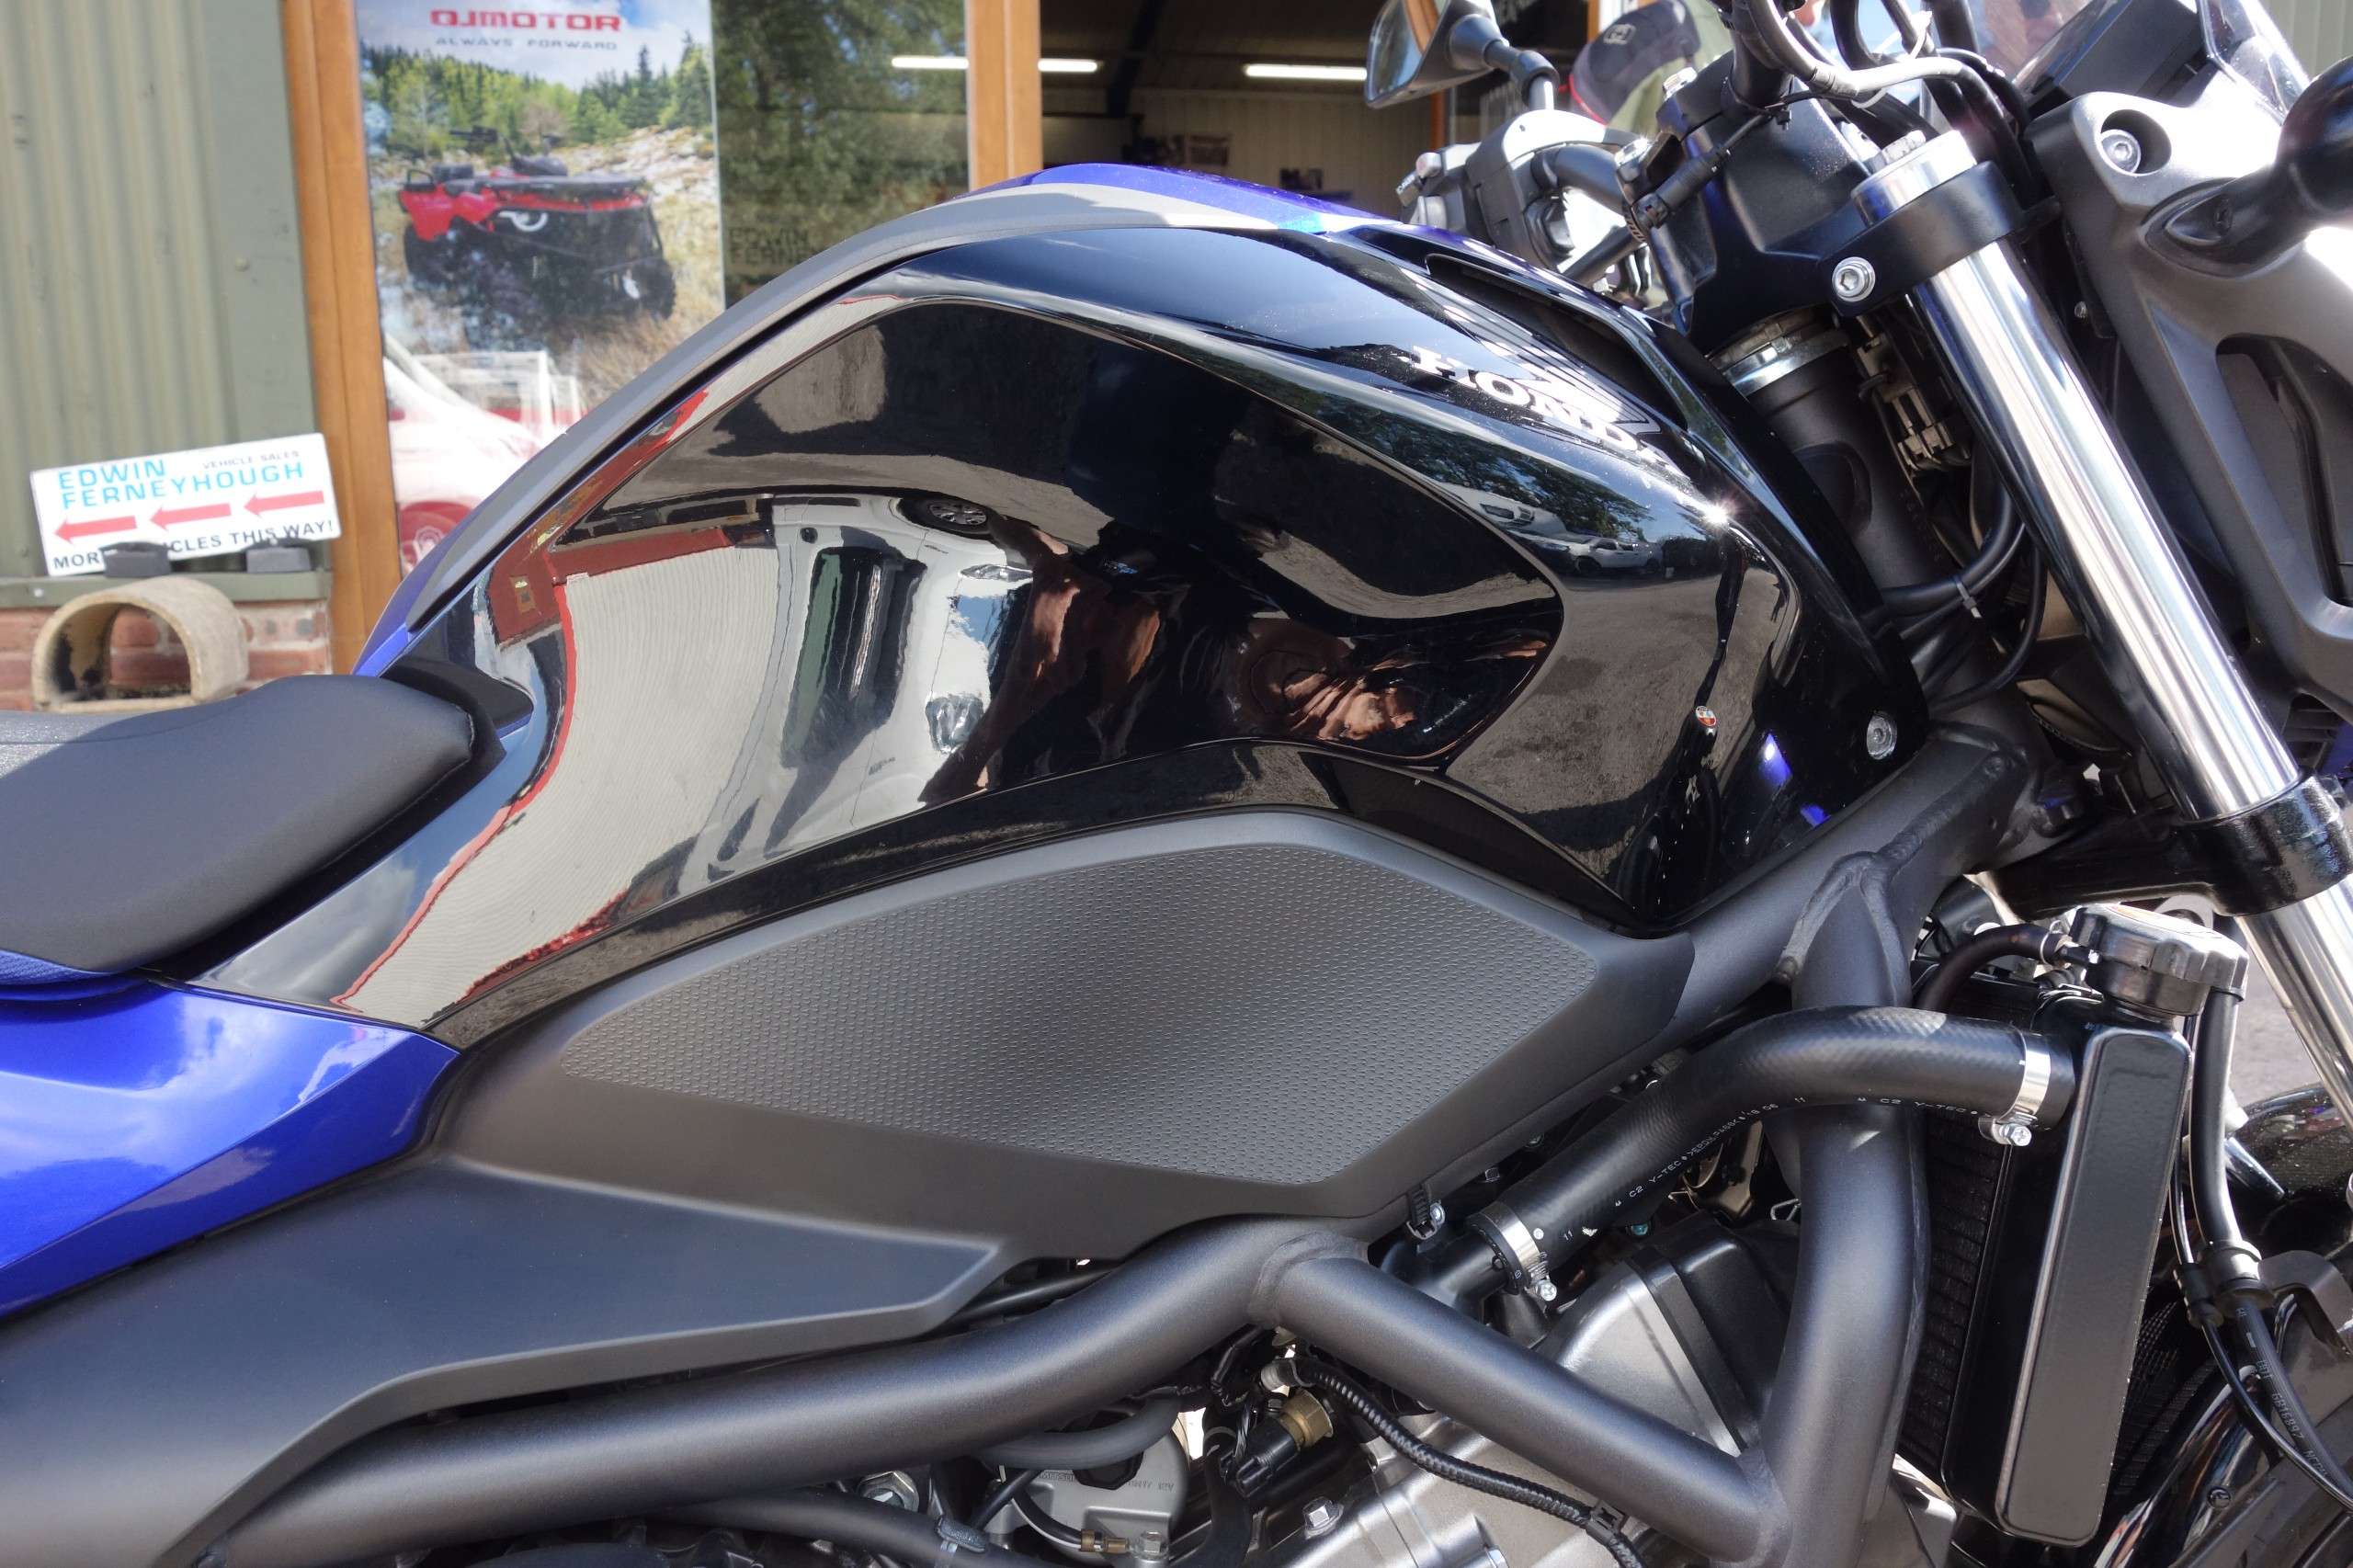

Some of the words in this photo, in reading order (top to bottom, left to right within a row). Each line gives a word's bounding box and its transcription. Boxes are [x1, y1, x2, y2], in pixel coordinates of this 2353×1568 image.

[430, 9, 621, 31] QJMOTOR
[436, 37, 514, 47] ALWAYS
[527, 38, 618, 51] FORWARD
[58, 460, 167, 490] EDWIN
[61, 461, 304, 510] FERNEYHOUGH
[52, 550, 101, 571] MOR
[228, 527, 277, 548] THIS
[282, 518, 335, 542] WAY!
[1628, 1185, 1644, 1199] C2
[1649, 1160, 1683, 1184] Y-TEC
